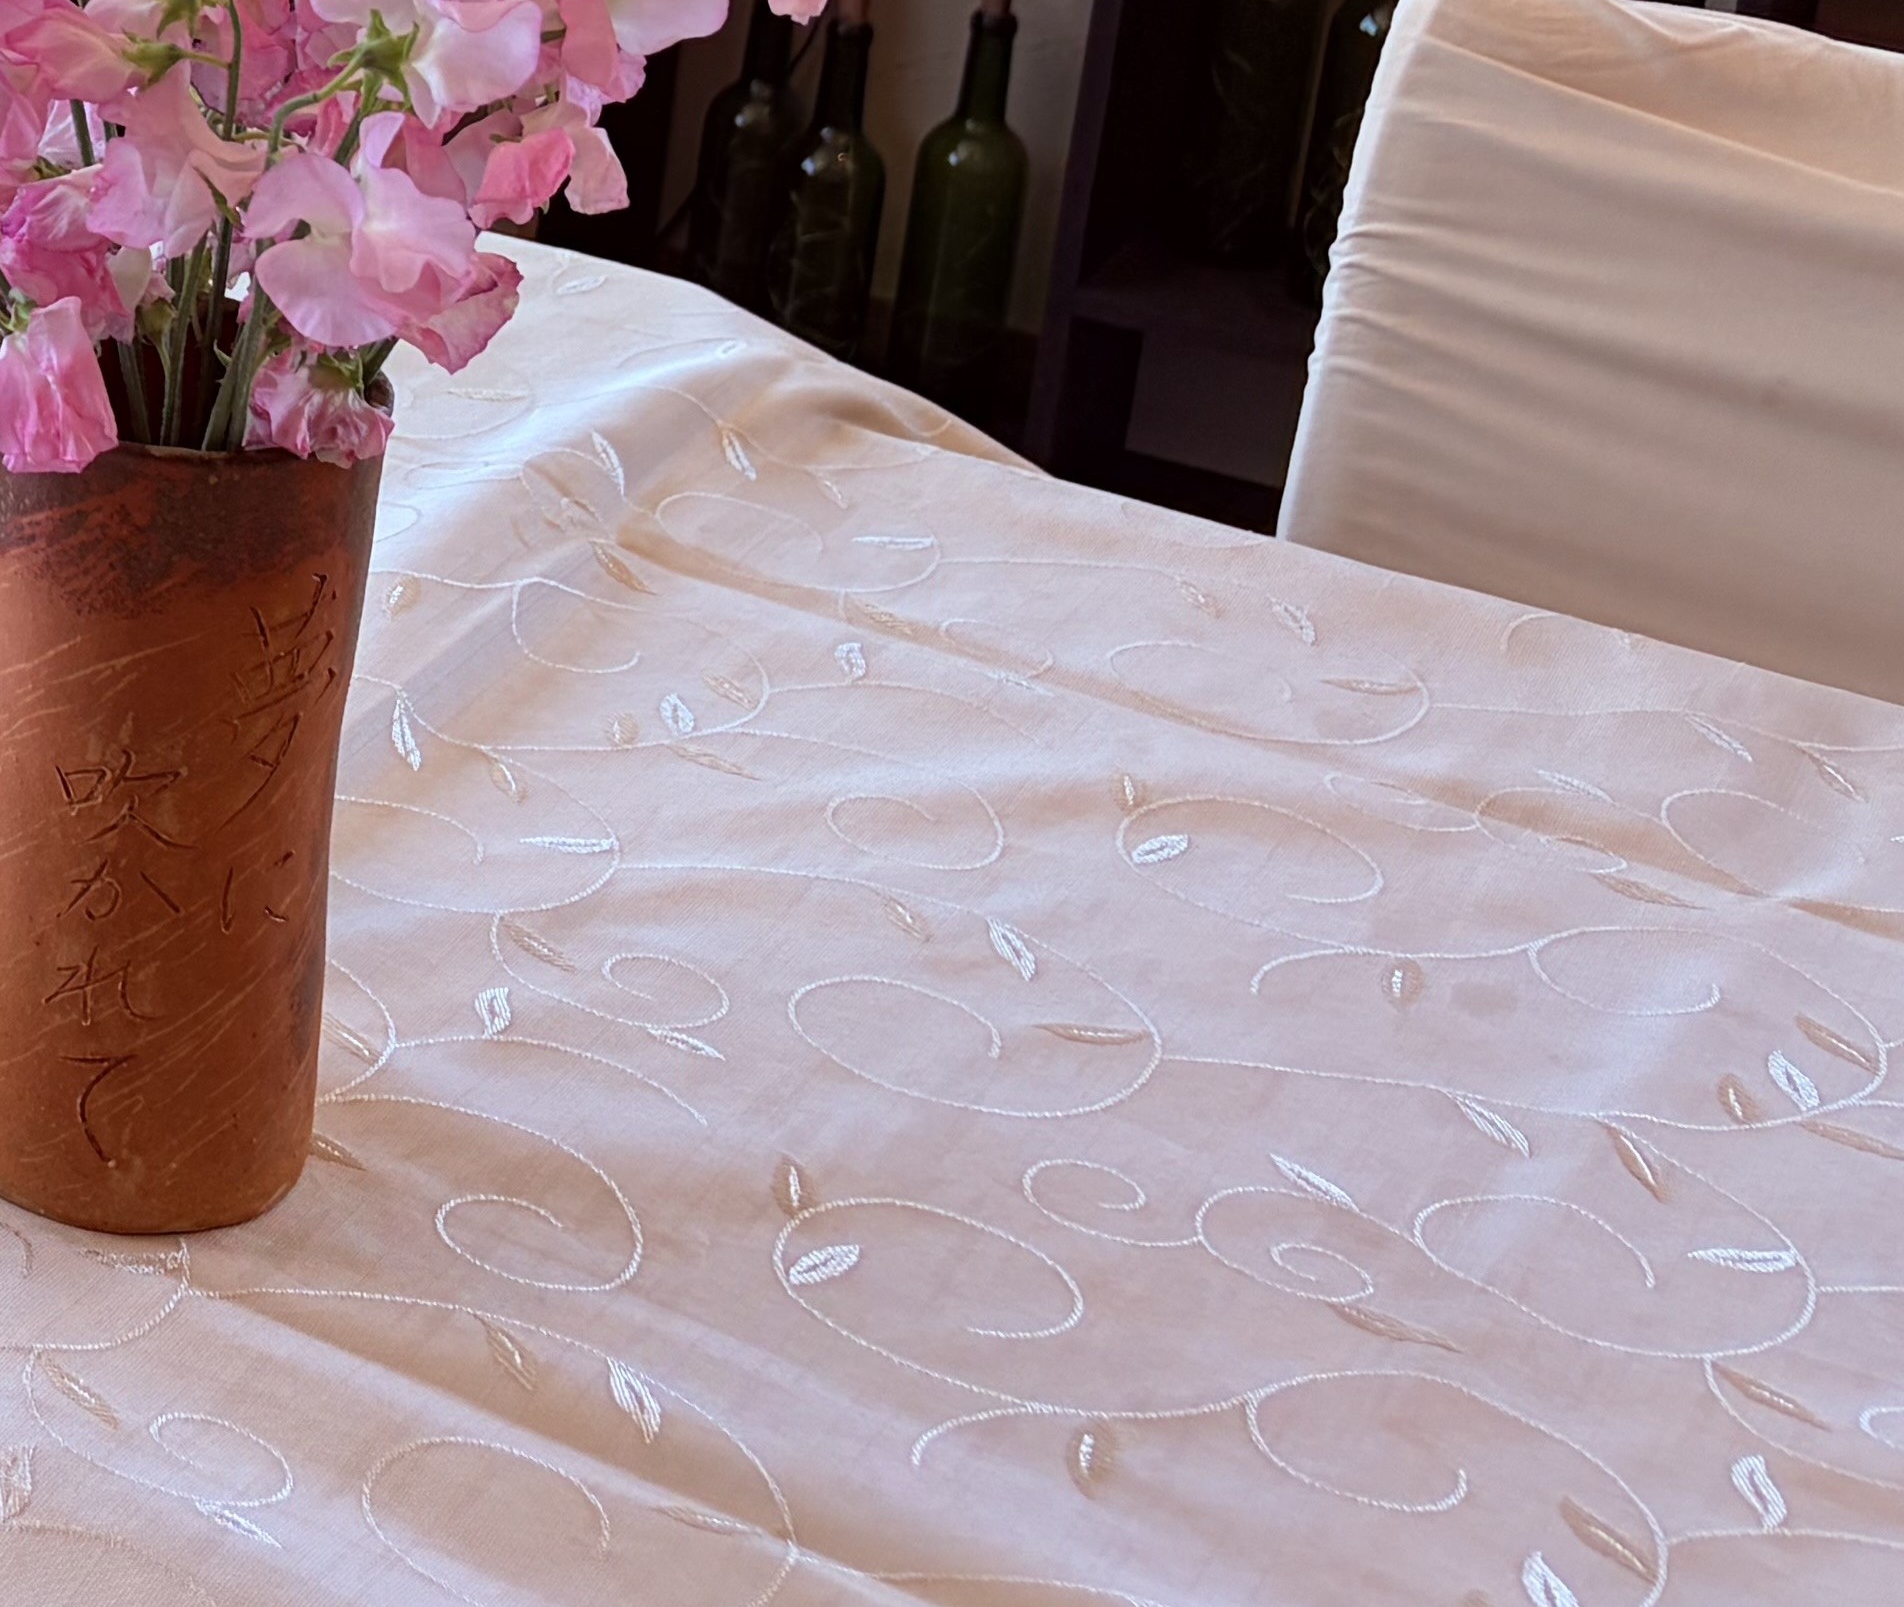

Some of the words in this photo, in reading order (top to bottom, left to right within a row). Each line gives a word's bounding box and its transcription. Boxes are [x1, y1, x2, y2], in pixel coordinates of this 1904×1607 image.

[214, 570, 338, 935] 夢に
[40, 746, 198, 1171] 吹かれて
